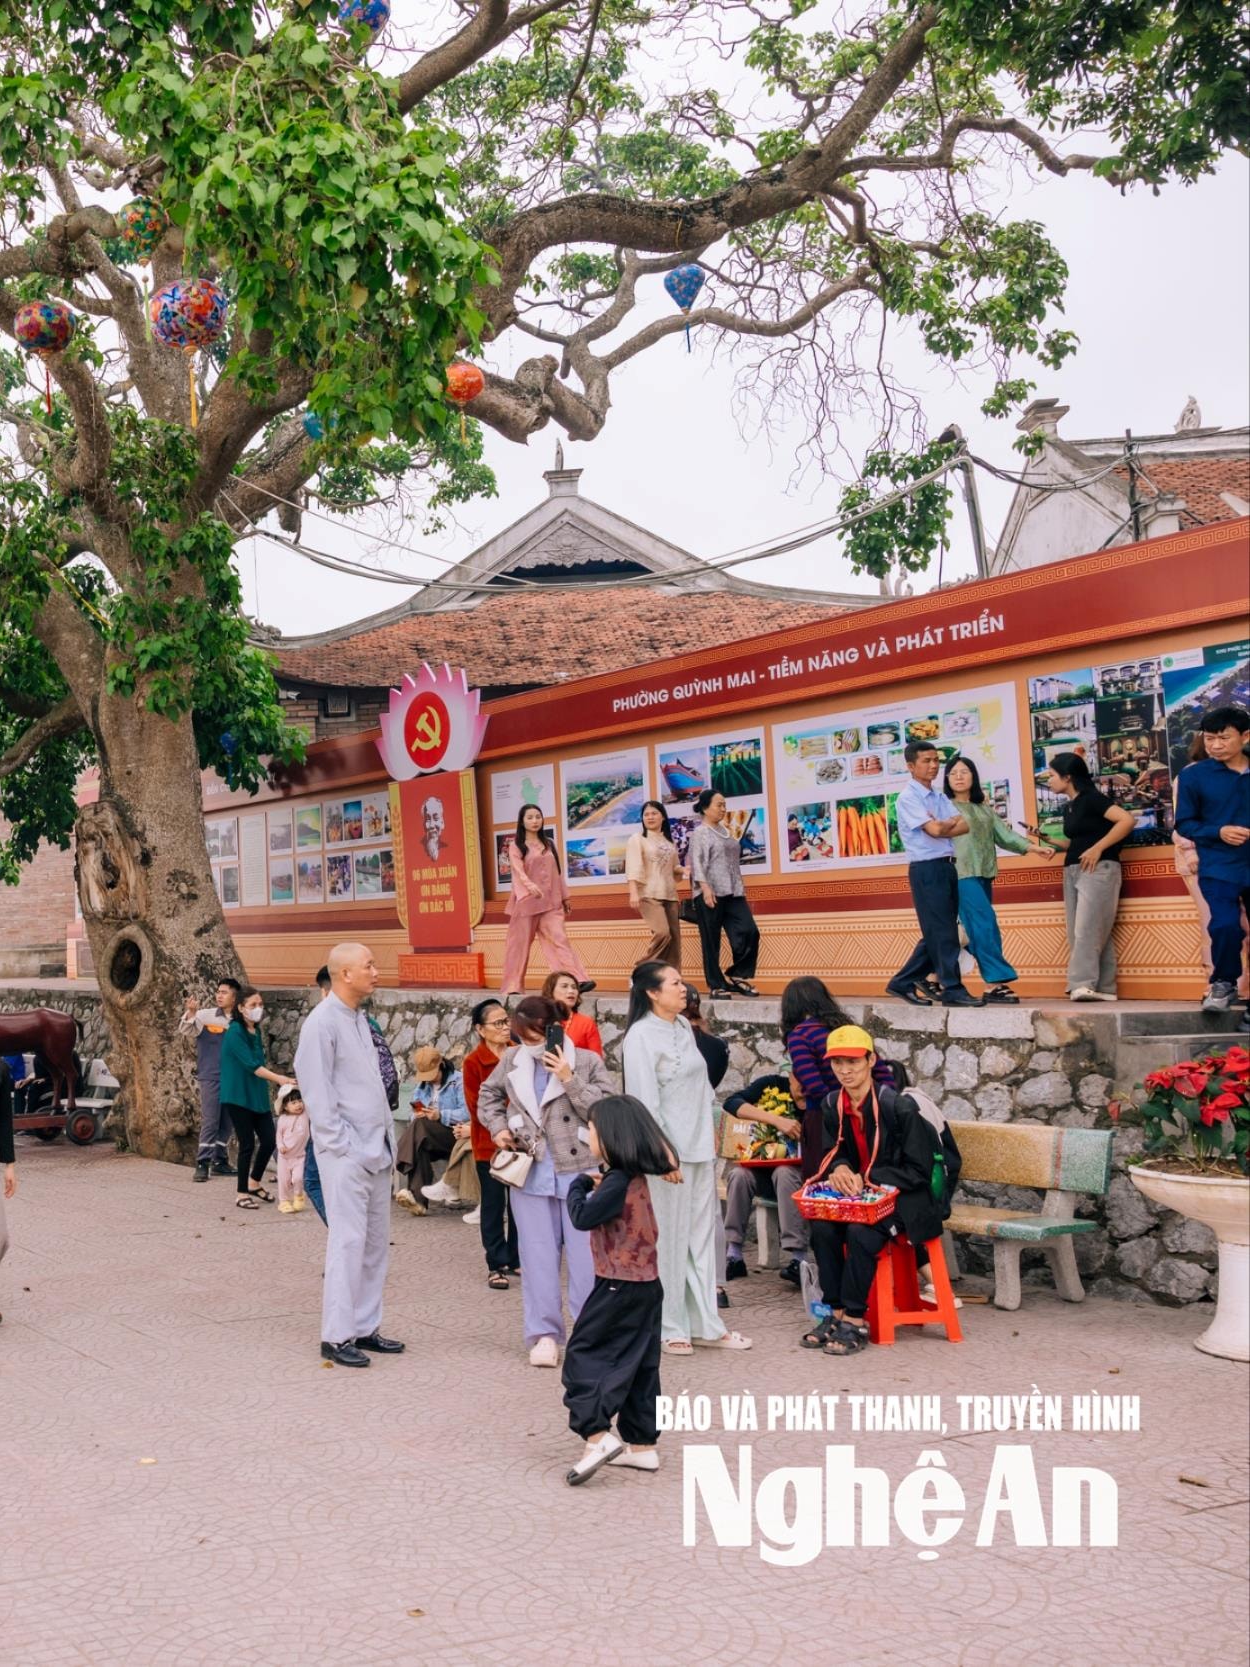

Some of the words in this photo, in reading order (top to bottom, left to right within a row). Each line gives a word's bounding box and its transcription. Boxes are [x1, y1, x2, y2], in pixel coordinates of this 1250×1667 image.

[613, 688, 669, 713] PHƯỜNG
[672, 678, 723, 700] QUỲNH
[727, 669, 756, 689] MAI
[768, 655, 804, 681] TIỀM
[808, 647, 860, 673] NĂNG
[863, 636, 891, 660] VÀ
[896, 625, 944, 653] PHÁT
[949, 608, 1005, 642] TRIỂN
